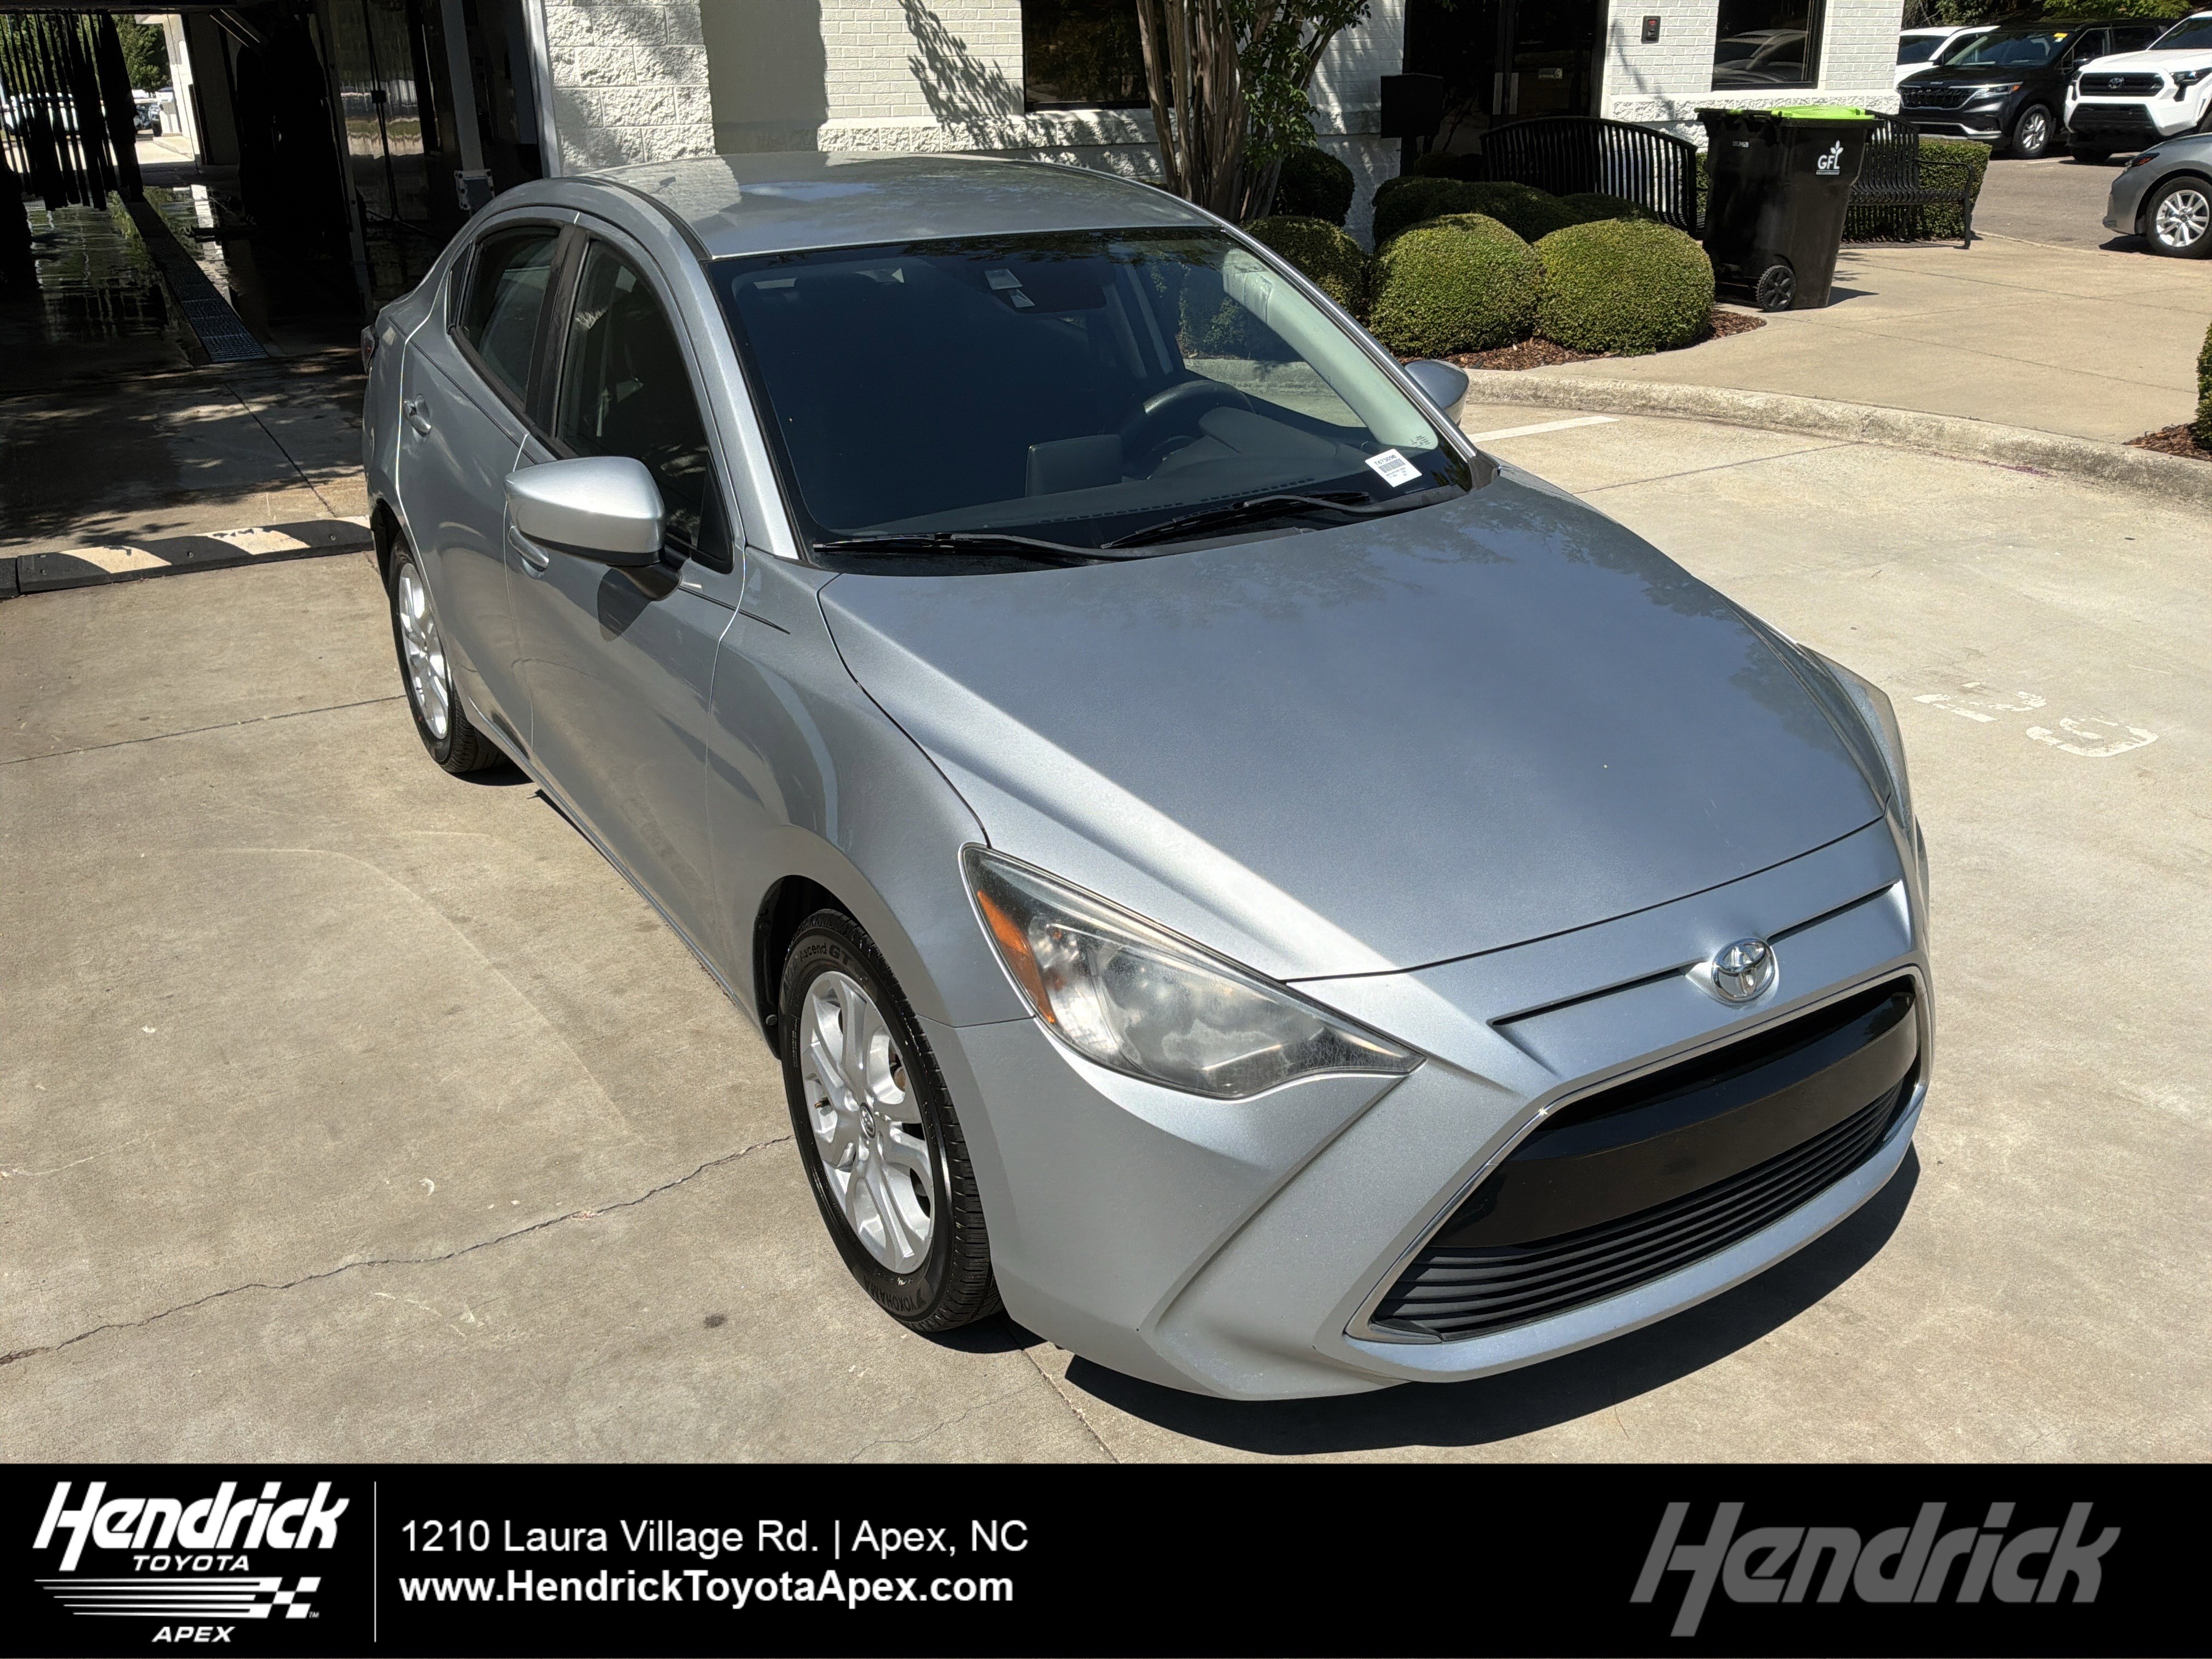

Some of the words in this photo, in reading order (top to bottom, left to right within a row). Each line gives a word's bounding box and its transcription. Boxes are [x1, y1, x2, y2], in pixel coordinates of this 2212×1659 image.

[1818, 153, 1840, 170] GFL
[799, 943, 827, 961] Ascend
[829, 945, 850, 965] GT
